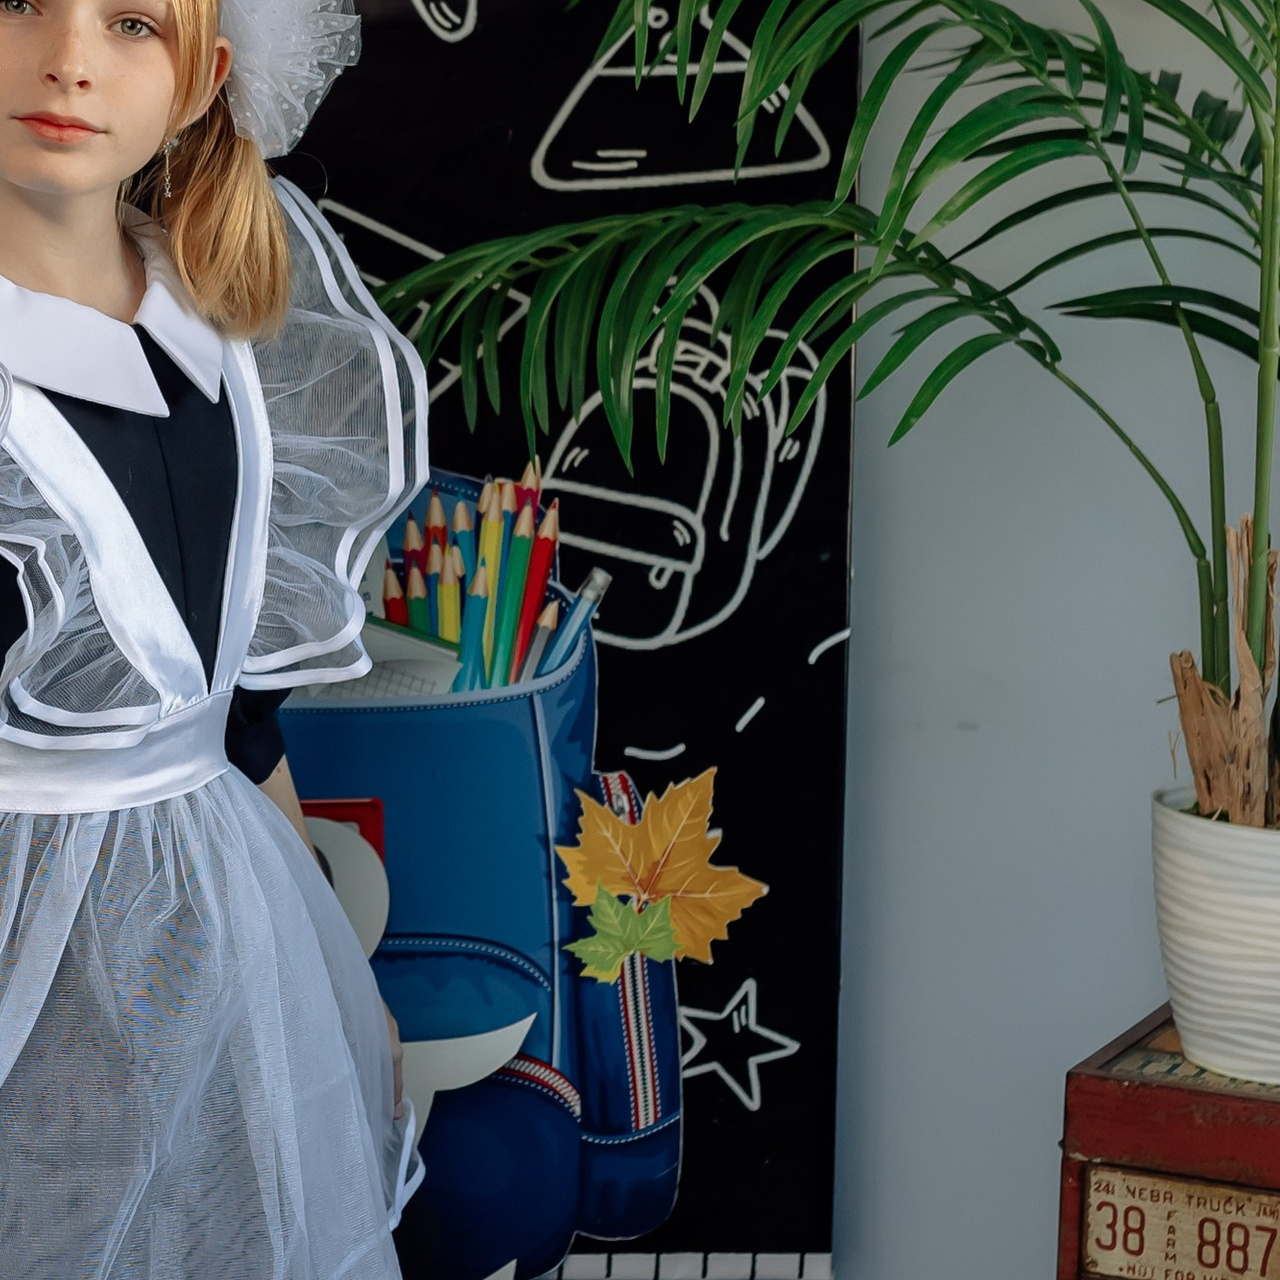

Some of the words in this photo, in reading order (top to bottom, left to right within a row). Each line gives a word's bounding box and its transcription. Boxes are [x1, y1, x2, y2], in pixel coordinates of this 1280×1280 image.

[1187, 1195, 1245, 1216] TRUCK
[1095, 1201, 1145, 1256] 38
[1165, 1210, 1178, 1264] FARM
[1198, 1217, 1277, 1277] 887
